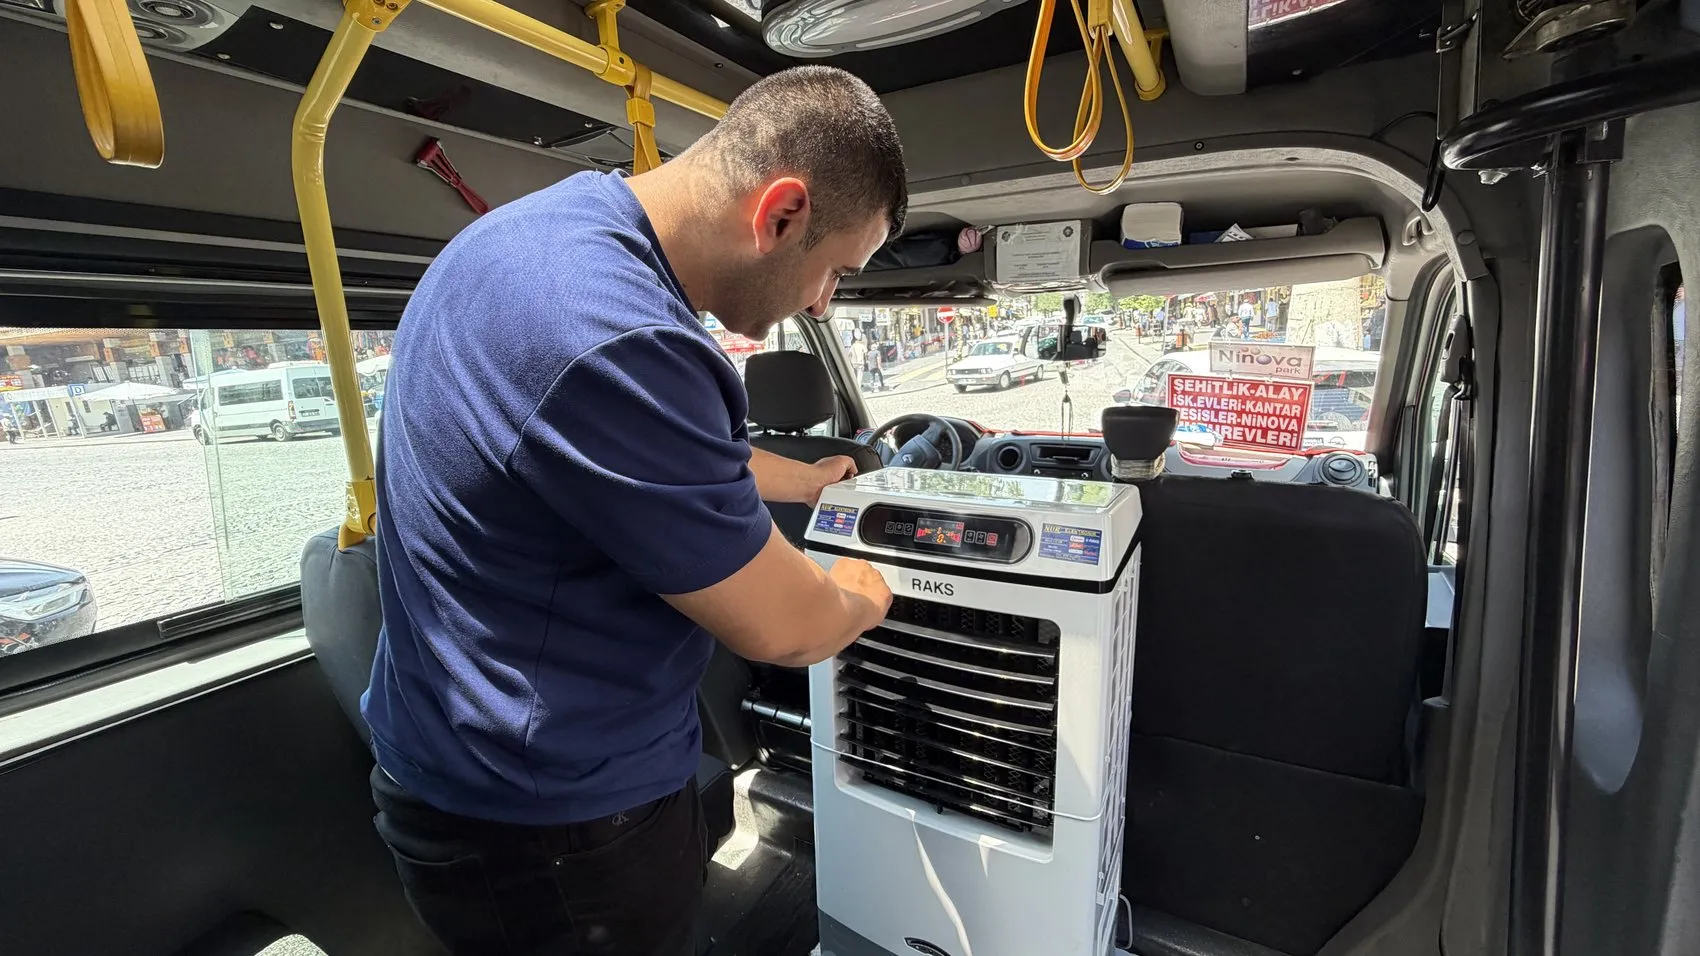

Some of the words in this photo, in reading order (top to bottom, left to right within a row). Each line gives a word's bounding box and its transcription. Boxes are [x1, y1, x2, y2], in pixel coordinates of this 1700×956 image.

[1218, 348, 1302, 368] Ninova
[1275, 366, 1301, 375] park
[911, 578, 954, 596] RAKS
